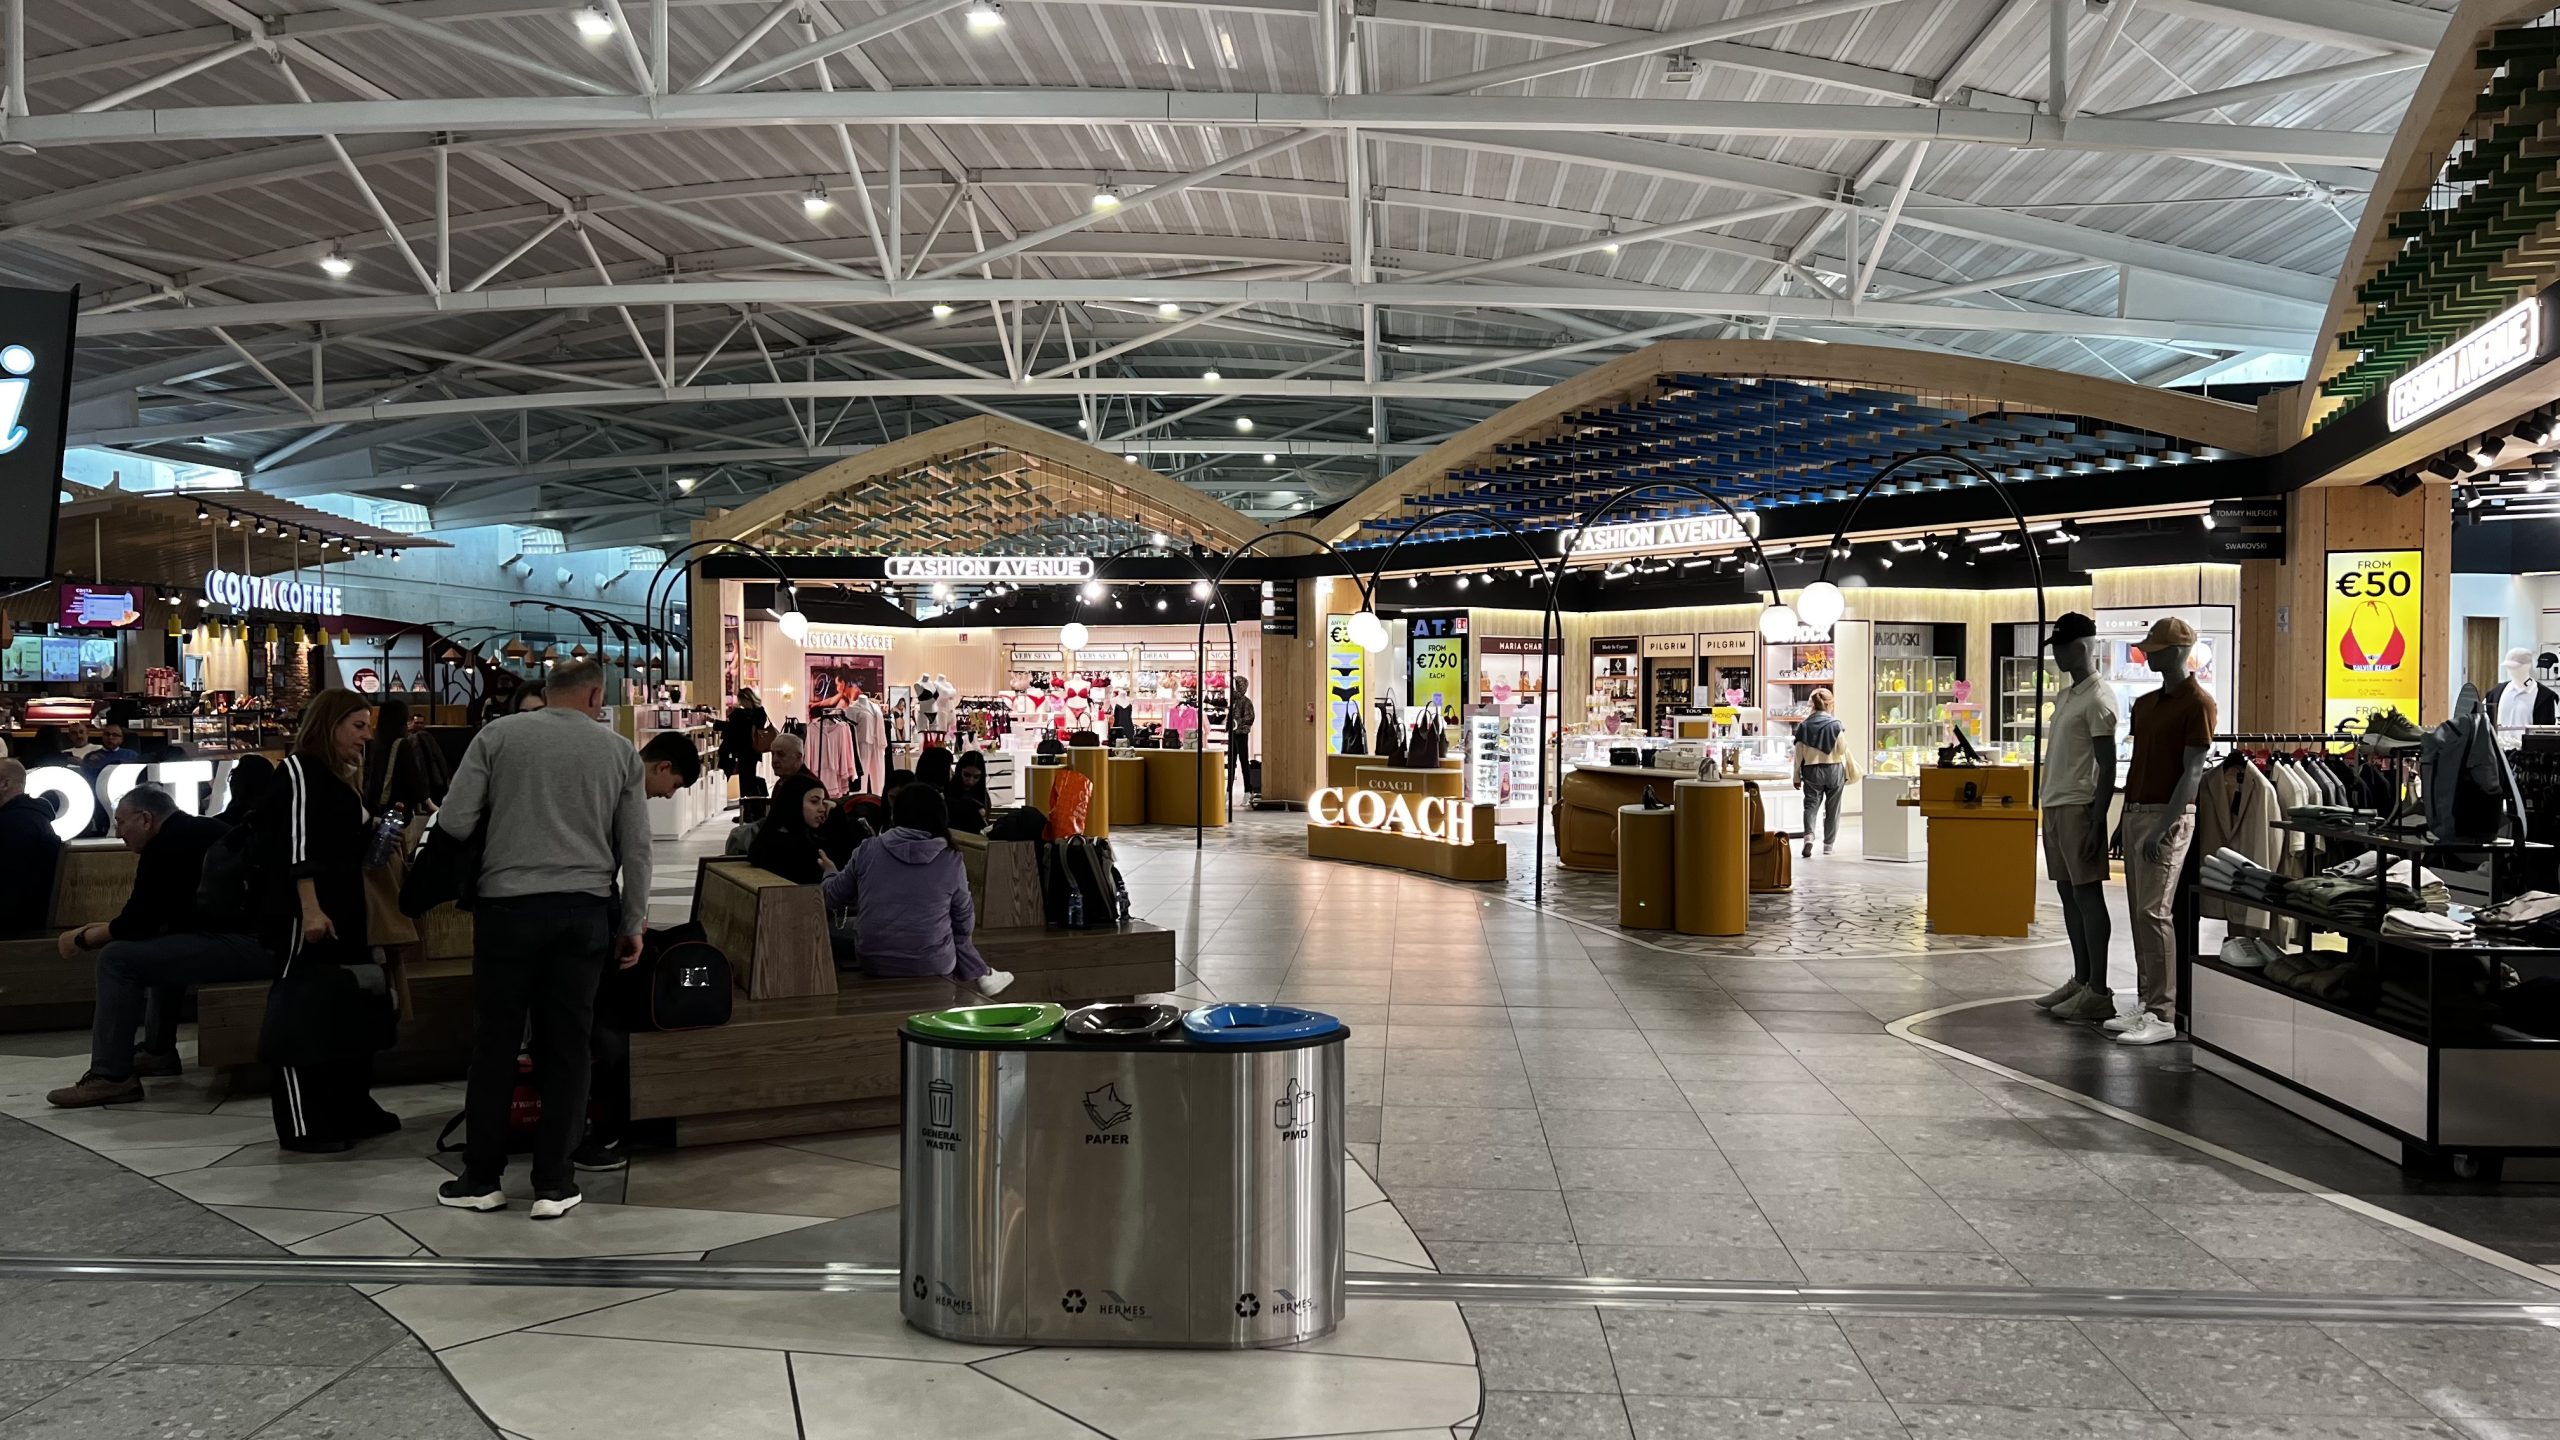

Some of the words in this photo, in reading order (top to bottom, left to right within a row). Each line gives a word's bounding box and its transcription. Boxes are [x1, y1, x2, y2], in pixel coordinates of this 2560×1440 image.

[1660, 518, 1748, 545] AVENUE
[2225, 542, 2267, 550] SWAROVSKI
[896, 560, 992, 576] FASHION
[996, 560, 1082, 576] AVENUE
[2358, 560, 2391, 569] FROM
[2336, 571, 2410, 597] €50
[860, 634, 896, 649] SECRET
[1500, 642, 1521, 650] MARIA
[1650, 642, 1687, 651] PILGRIM
[1707, 640, 1746, 649] PILGRIM
[1144, 652, 1169, 660] DREAM
[1416, 653, 1458, 668] €7.90
[2356, 706, 2388, 715] FROM
[1368, 779, 1413, 791] COACH
[1308, 786, 1475, 846] COACH
[921, 1128, 962, 1141] GENERAL
[1085, 1133, 1129, 1144] PAPER
[1282, 1129, 1308, 1141] PMD
[926, 1139, 956, 1151] WASTE
[936, 1295, 973, 1311] HERMES
[1100, 1303, 1145, 1315] HERMES
[1272, 1297, 1312, 1315] HERMES
